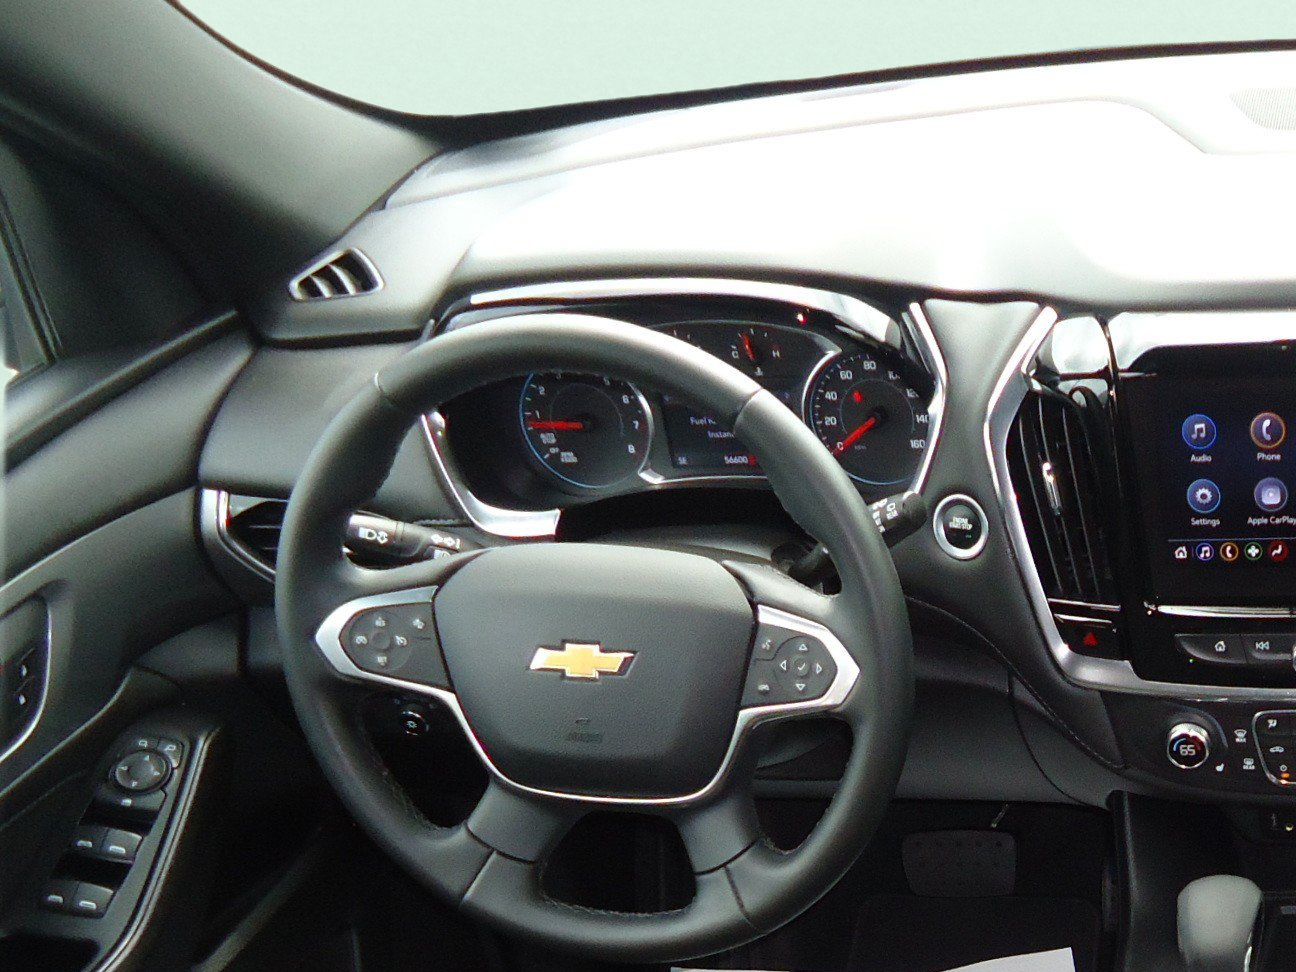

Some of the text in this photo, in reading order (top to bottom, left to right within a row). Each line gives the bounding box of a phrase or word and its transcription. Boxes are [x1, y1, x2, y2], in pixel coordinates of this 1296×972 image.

[863, 360, 877, 370] 80
[839, 370, 853, 380] 60
[538, 385, 546, 395] 2
[825, 391, 838, 400] 40
[632, 419, 640, 430] 7
[824, 416, 838, 426] 20
[627, 444, 636, 454] 8
[910, 439, 926, 449] 160
[1190, 453, 1212, 463] Audio
[1256, 452, 1281, 462] Phone
[1190, 517, 1221, 527] Settings
[1247, 516, 1269, 527] Apple
[1180, 744, 1196, 756] 65
